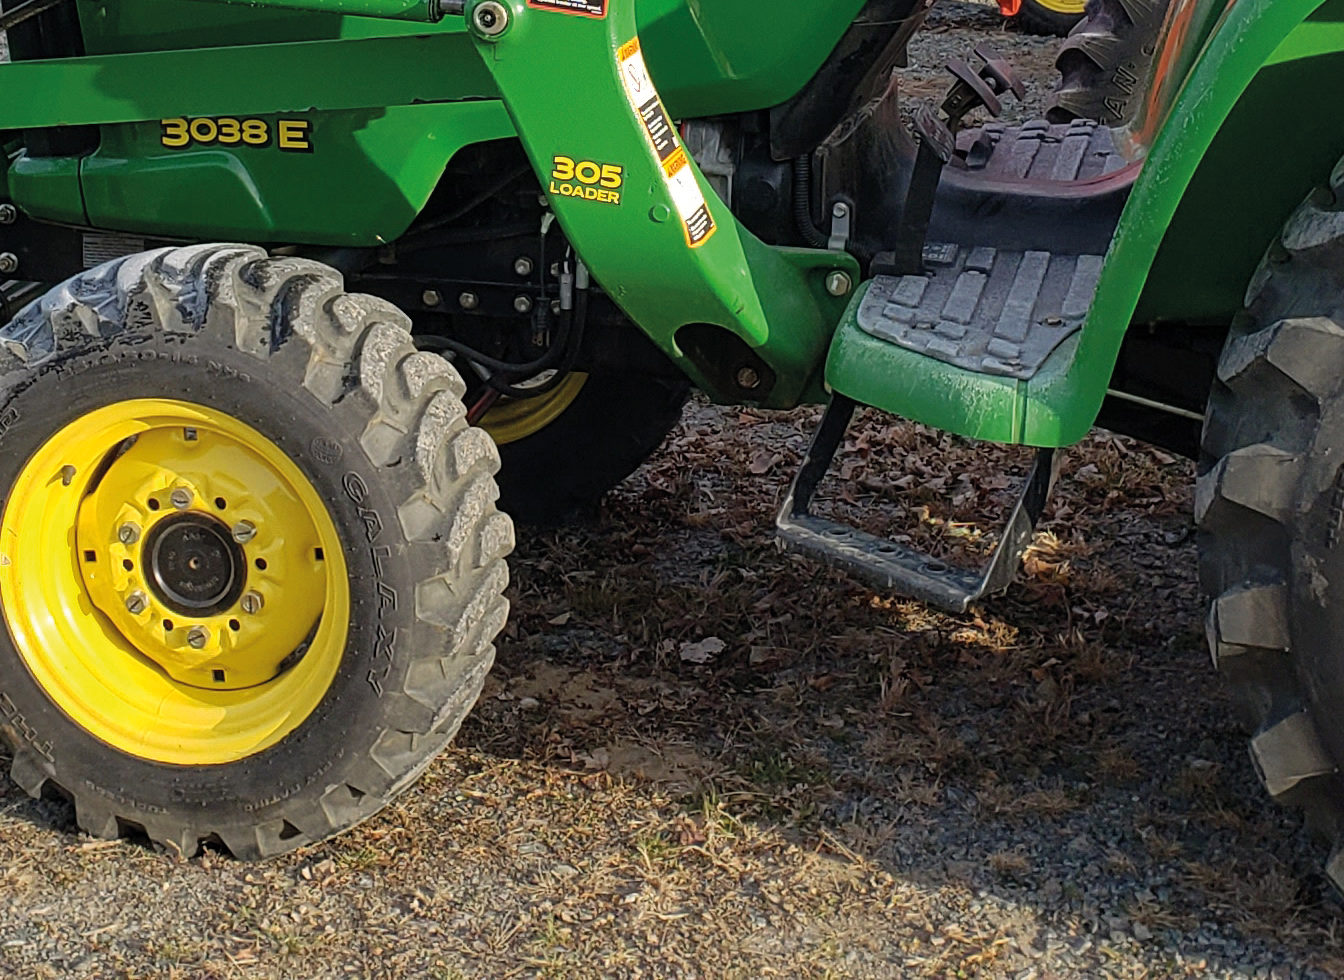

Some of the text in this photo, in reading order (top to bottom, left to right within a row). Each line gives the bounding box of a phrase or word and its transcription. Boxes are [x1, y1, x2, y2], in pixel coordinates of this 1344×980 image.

[161, 117, 309, 149] 3038 E
[551, 156, 624, 189] 305
[549, 180, 621, 206] LOADER
[342, 470, 399, 699] GALAXY
